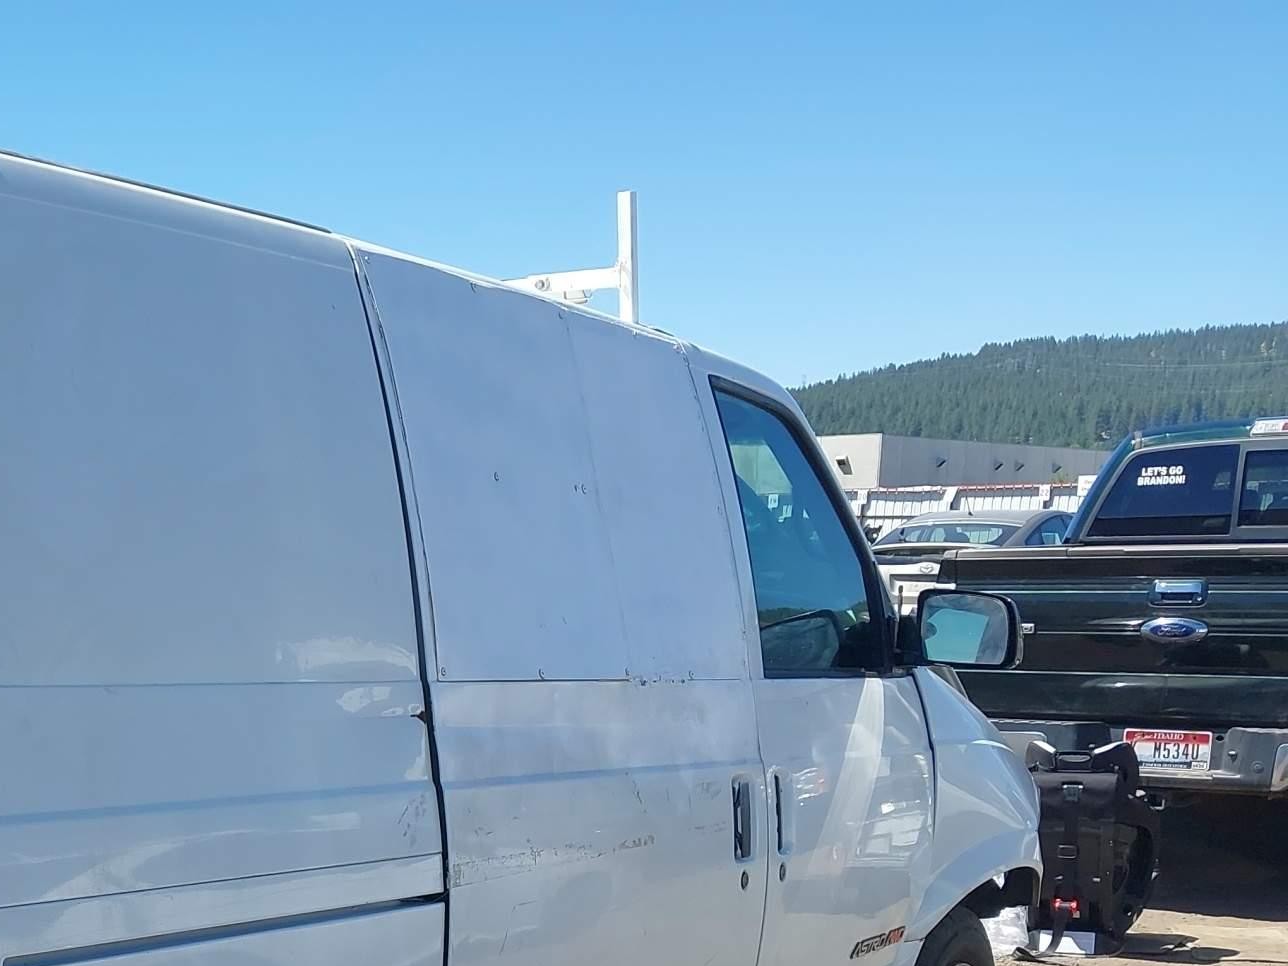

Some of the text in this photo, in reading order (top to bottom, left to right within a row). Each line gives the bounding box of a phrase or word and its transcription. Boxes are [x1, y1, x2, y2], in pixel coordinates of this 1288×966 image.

[1141, 465, 1184, 477] LET'S GO
[1137, 475, 1186, 486] BRANDON!
[1157, 624, 1187, 636] Ford
[1155, 732, 1184, 741] IDAHO
